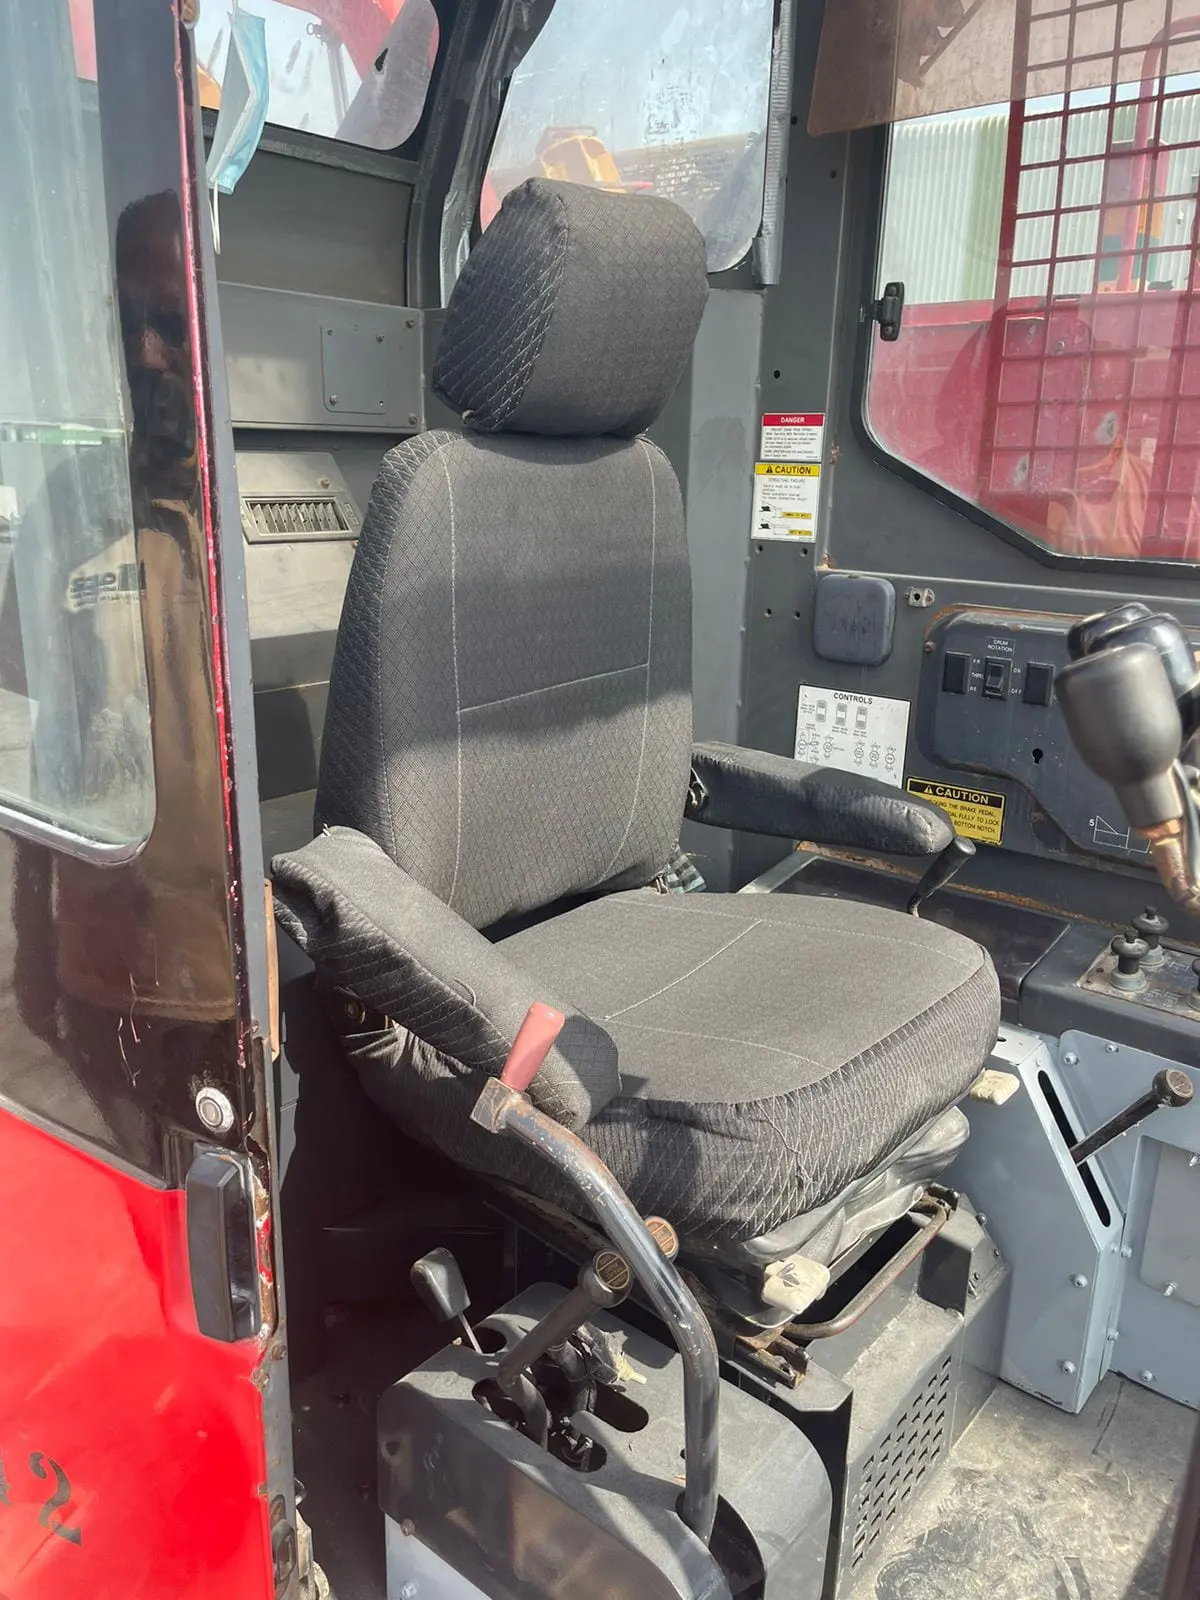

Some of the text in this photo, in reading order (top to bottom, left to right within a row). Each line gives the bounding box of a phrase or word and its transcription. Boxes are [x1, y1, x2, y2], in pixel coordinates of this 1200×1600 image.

[780, 416, 806, 424] DANGER
[774, 465, 812, 475] CAUTION
[987, 644, 1013, 652] ROTATION
[833, 692, 873, 705] CONTROLS
[935, 787, 989, 804] CAUTION
[959, 804, 977, 814] BRAKE
[953, 820, 976, 829] BOTTOM
[958, 813, 975, 821] FULLY
[985, 818, 1000, 826] LOCK
[1088, 818, 1096, 827] 5
